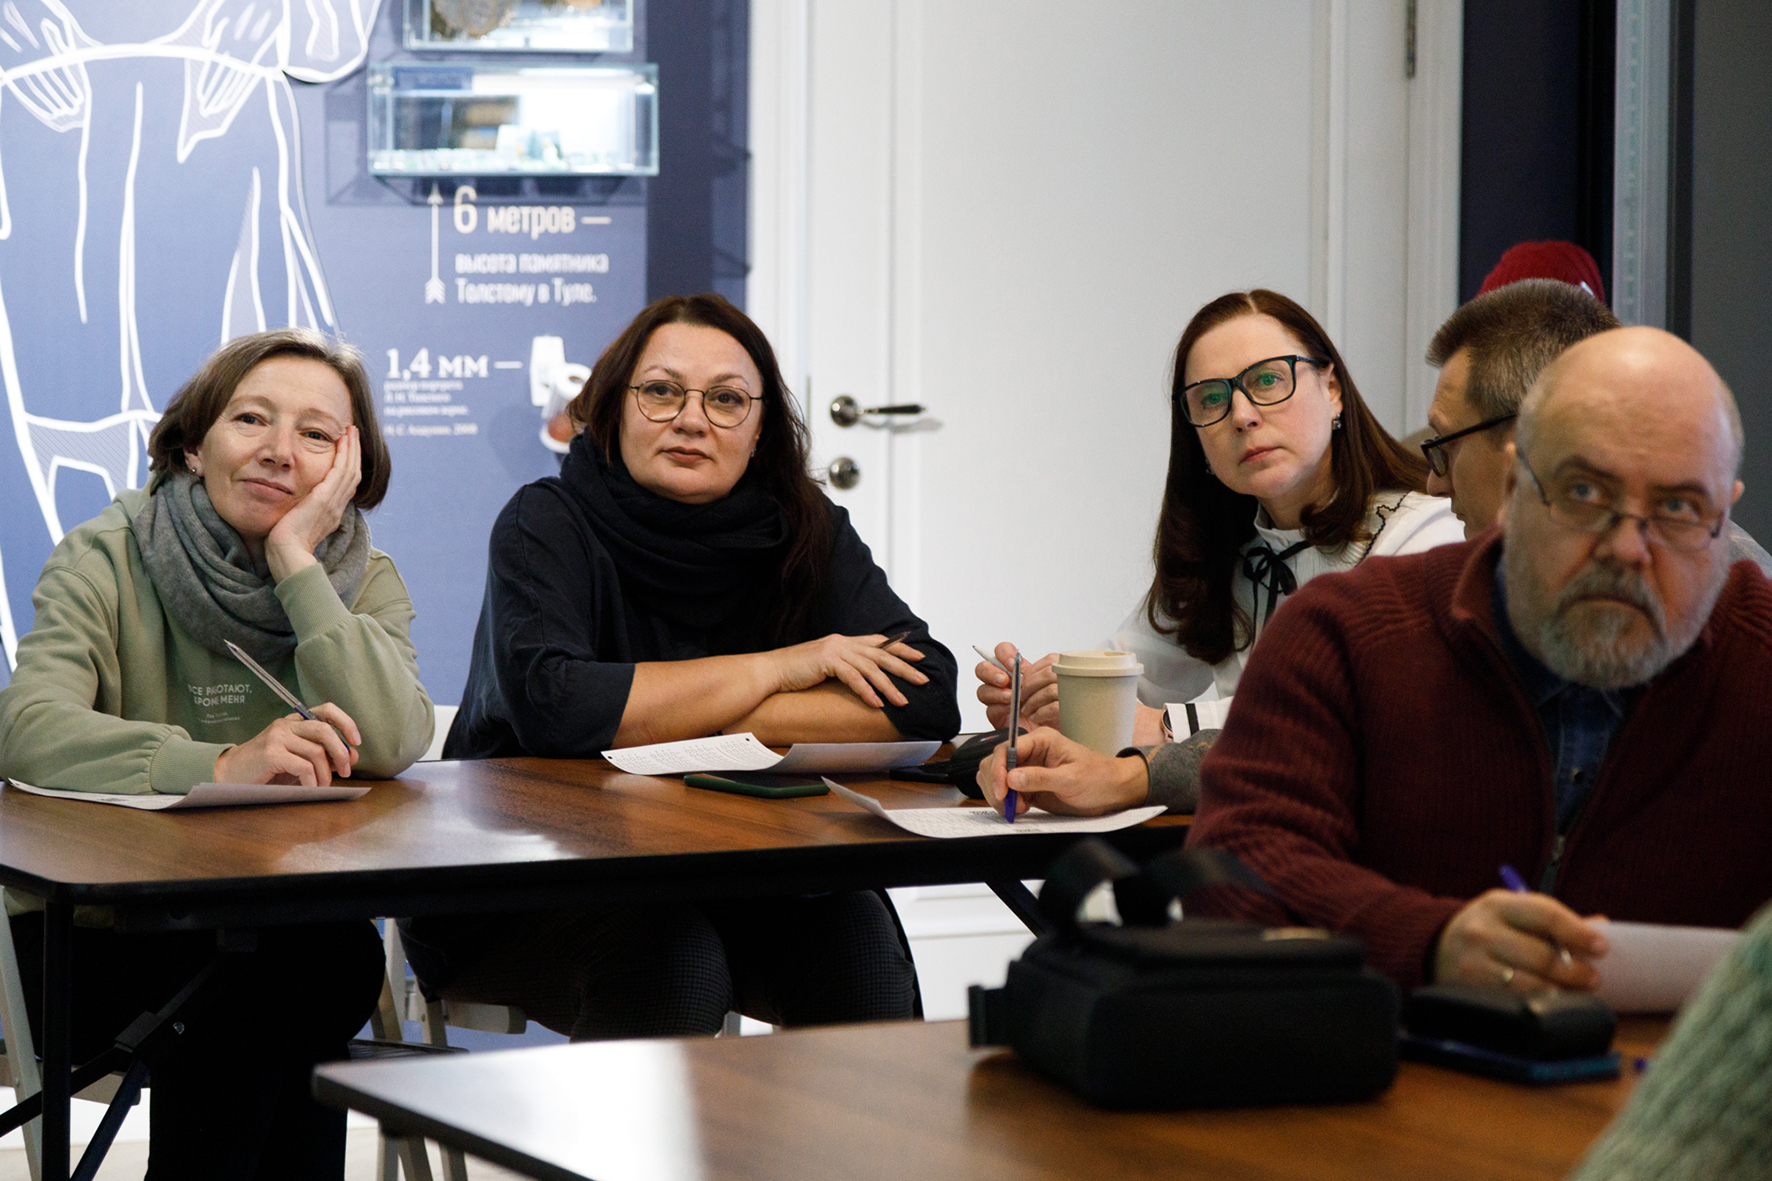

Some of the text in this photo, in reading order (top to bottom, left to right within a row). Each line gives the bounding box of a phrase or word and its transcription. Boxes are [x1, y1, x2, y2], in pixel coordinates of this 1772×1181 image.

[454, 185, 477, 234] 6
[488, 206, 575, 240] метров
[455, 253, 609, 273] высота памятника
[455, 277, 597, 306] Толстому в Туле.
[386, 347, 432, 381] 1,4
[220, 695, 245, 704] МЕНЯ
